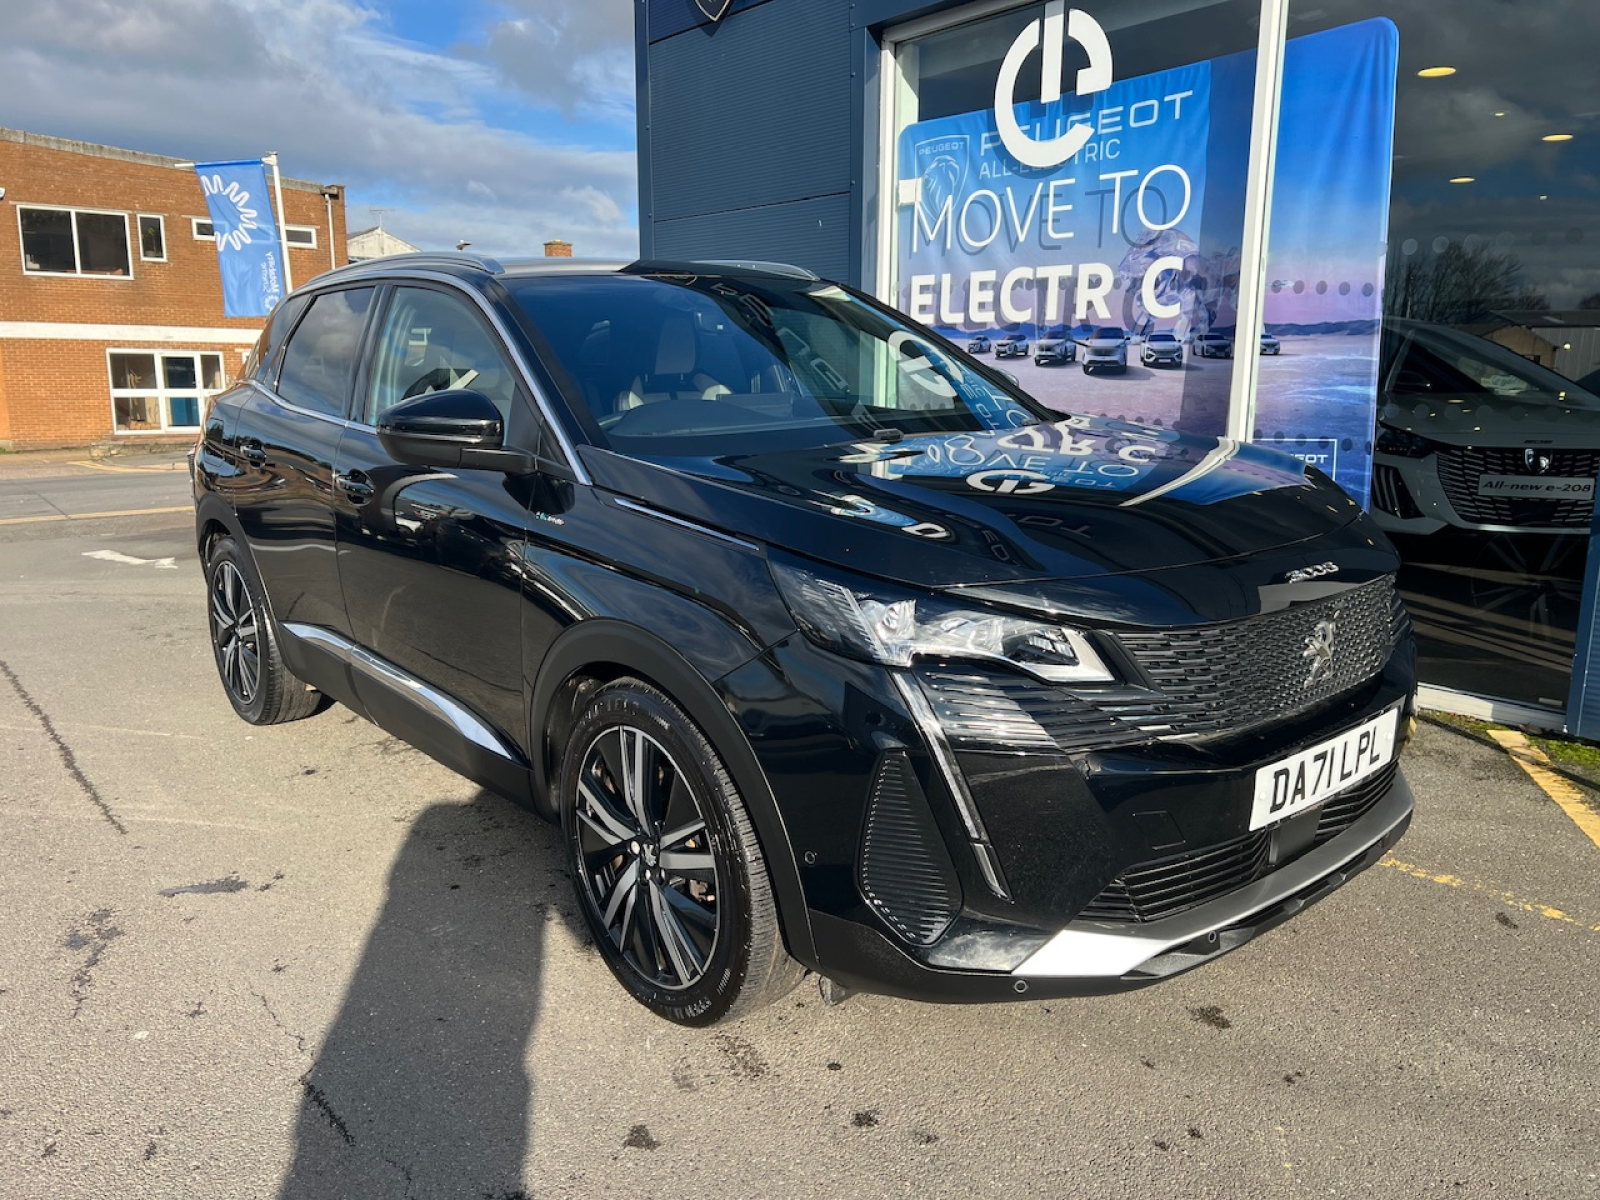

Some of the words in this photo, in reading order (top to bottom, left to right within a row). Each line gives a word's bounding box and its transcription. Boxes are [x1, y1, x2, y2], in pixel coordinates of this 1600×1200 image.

[918, 141, 965, 155] PEUGEOT
[978, 138, 1121, 180] ALL-ETRIC
[912, 178, 1076, 252] MOVE
[1099, 164, 1192, 235] TO
[1482, 480, 1543, 491] All-new
[1545, 484, 1592, 492] e-208
